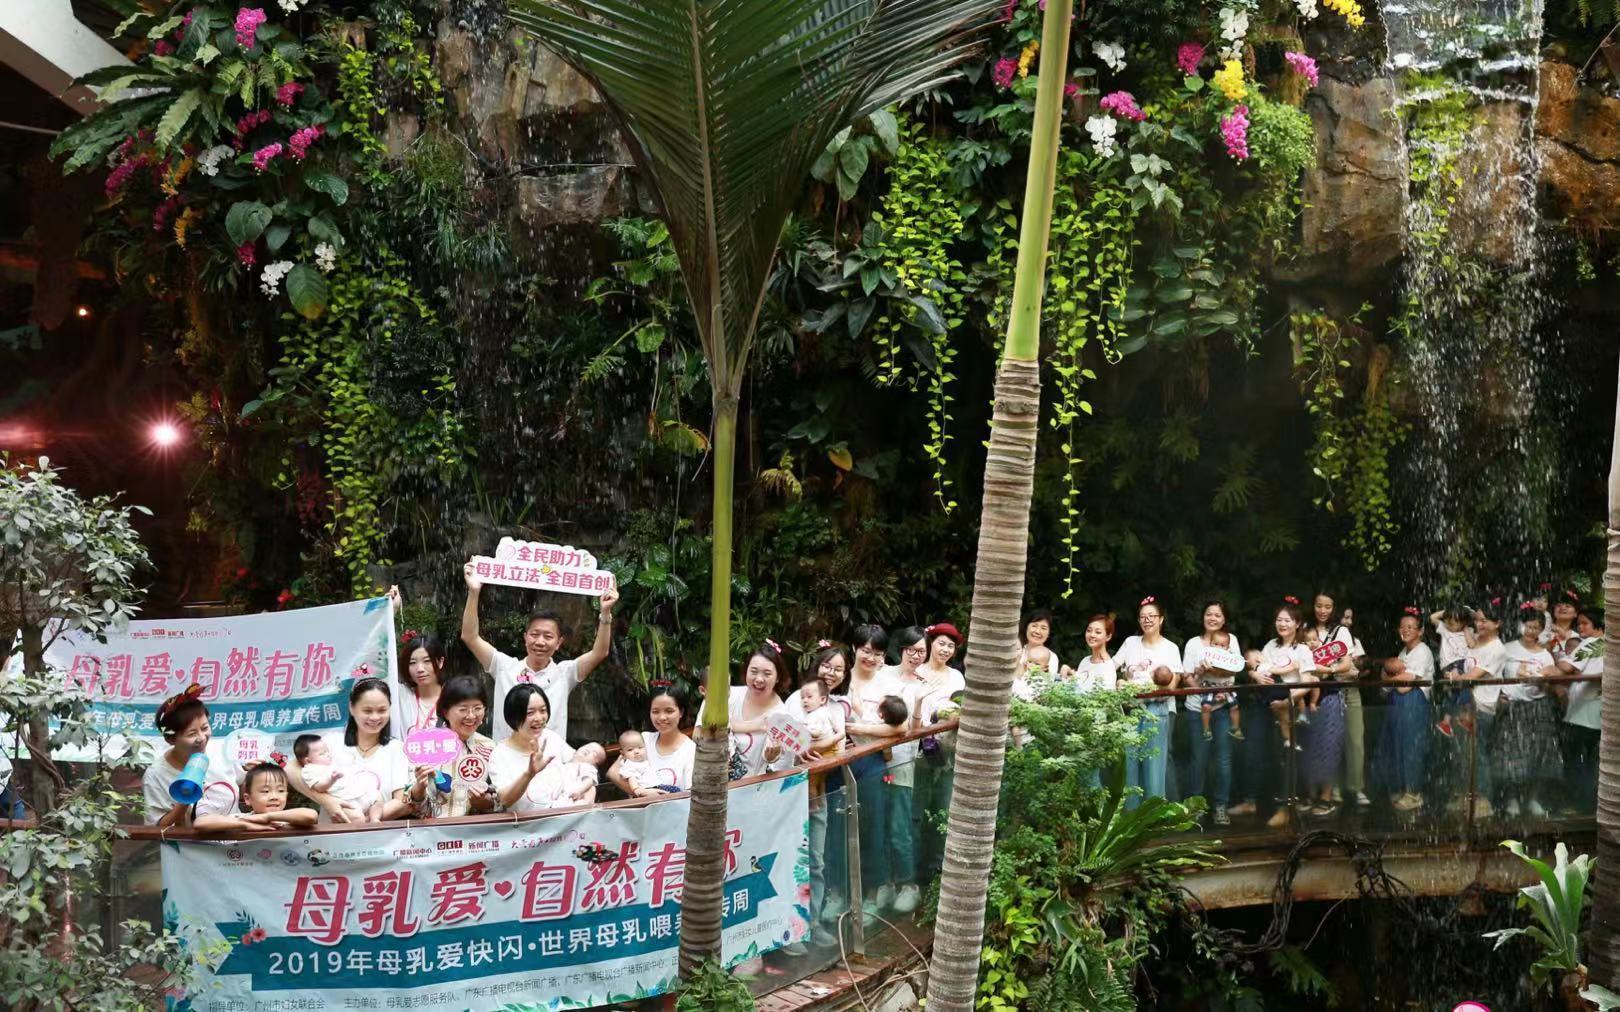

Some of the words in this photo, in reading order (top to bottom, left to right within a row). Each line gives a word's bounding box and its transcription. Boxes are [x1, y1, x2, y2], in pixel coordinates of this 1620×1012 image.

[517, 546, 581, 568] 全民助力
[475, 562, 541, 584] 母乳立法
[545, 570, 610, 591] 全国首创
